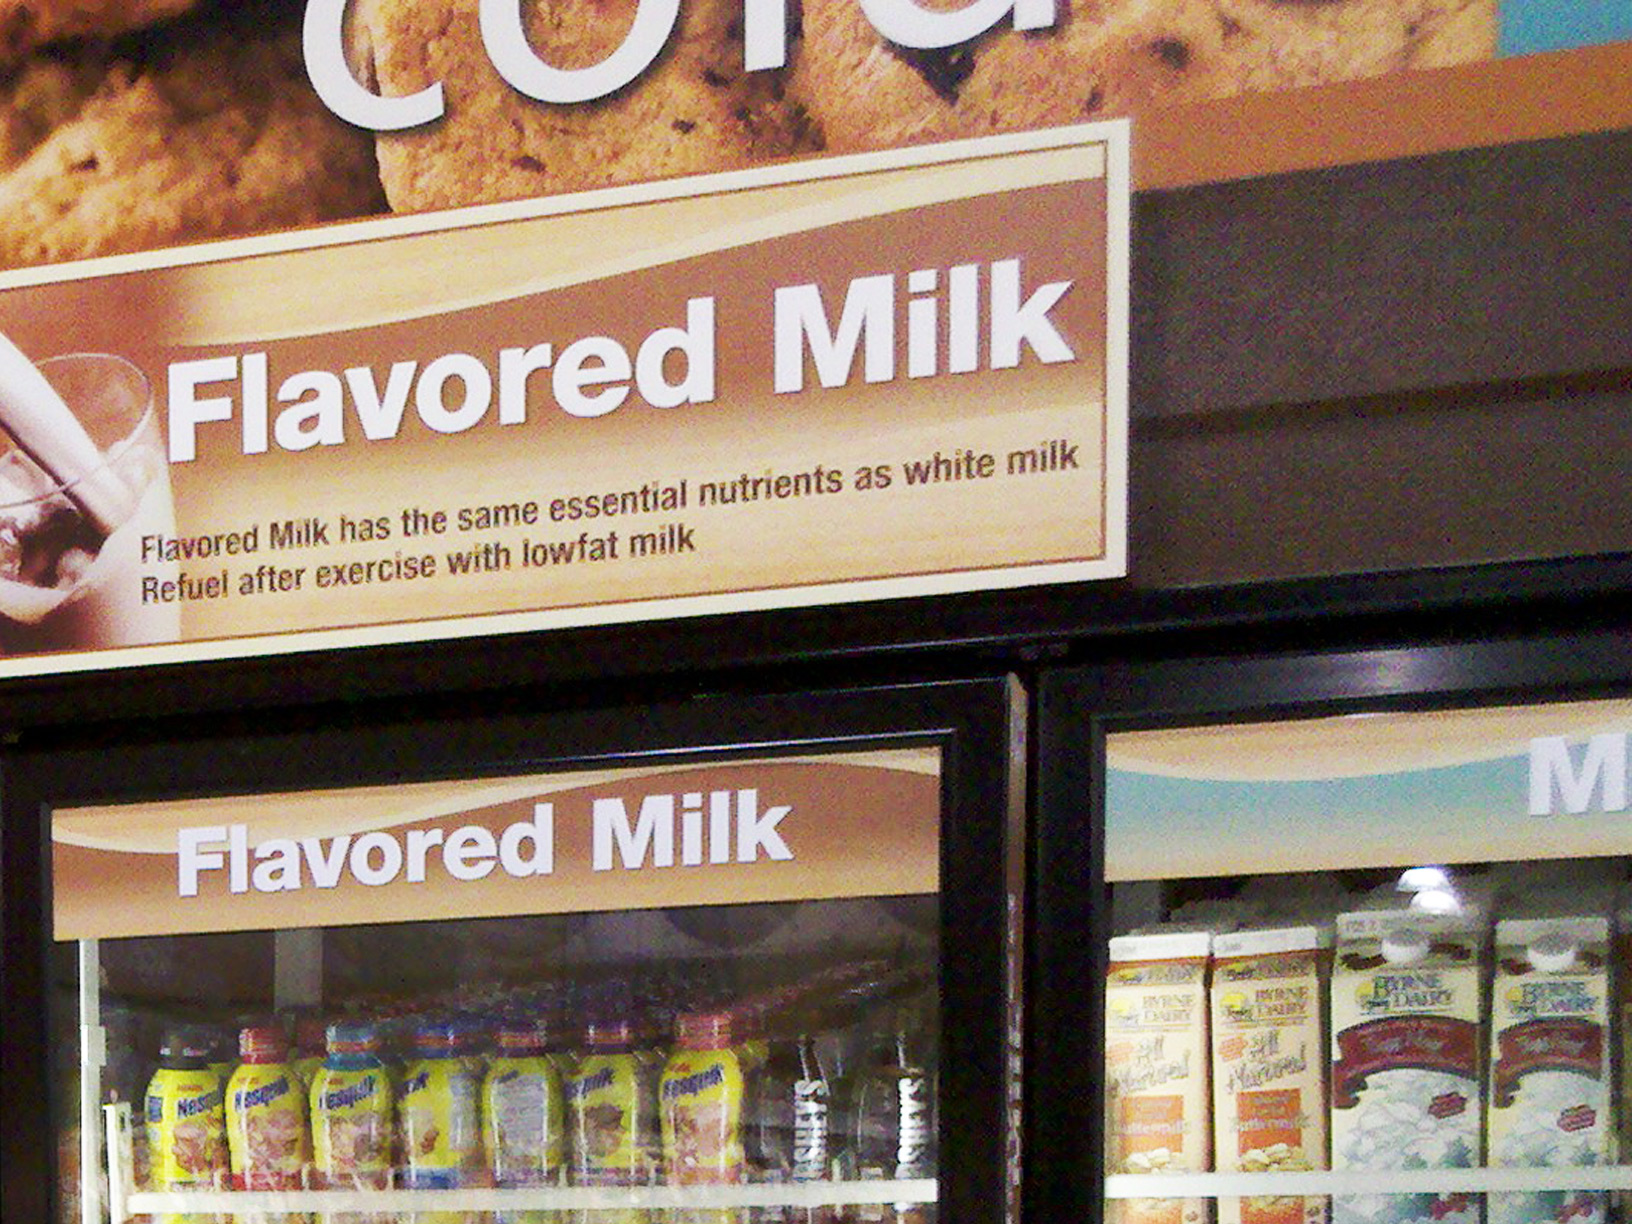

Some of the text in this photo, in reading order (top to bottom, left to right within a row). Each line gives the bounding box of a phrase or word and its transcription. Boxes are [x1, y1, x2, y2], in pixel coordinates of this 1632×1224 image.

[168, 257, 1078, 464] Flavored Milk
[141, 439, 1079, 565] Flavored Milk has the same essential nutrients as white milk
[141, 524, 695, 604] Refuel after exercise with lowfat milk
[177, 787, 794, 898] Flavored Milk
